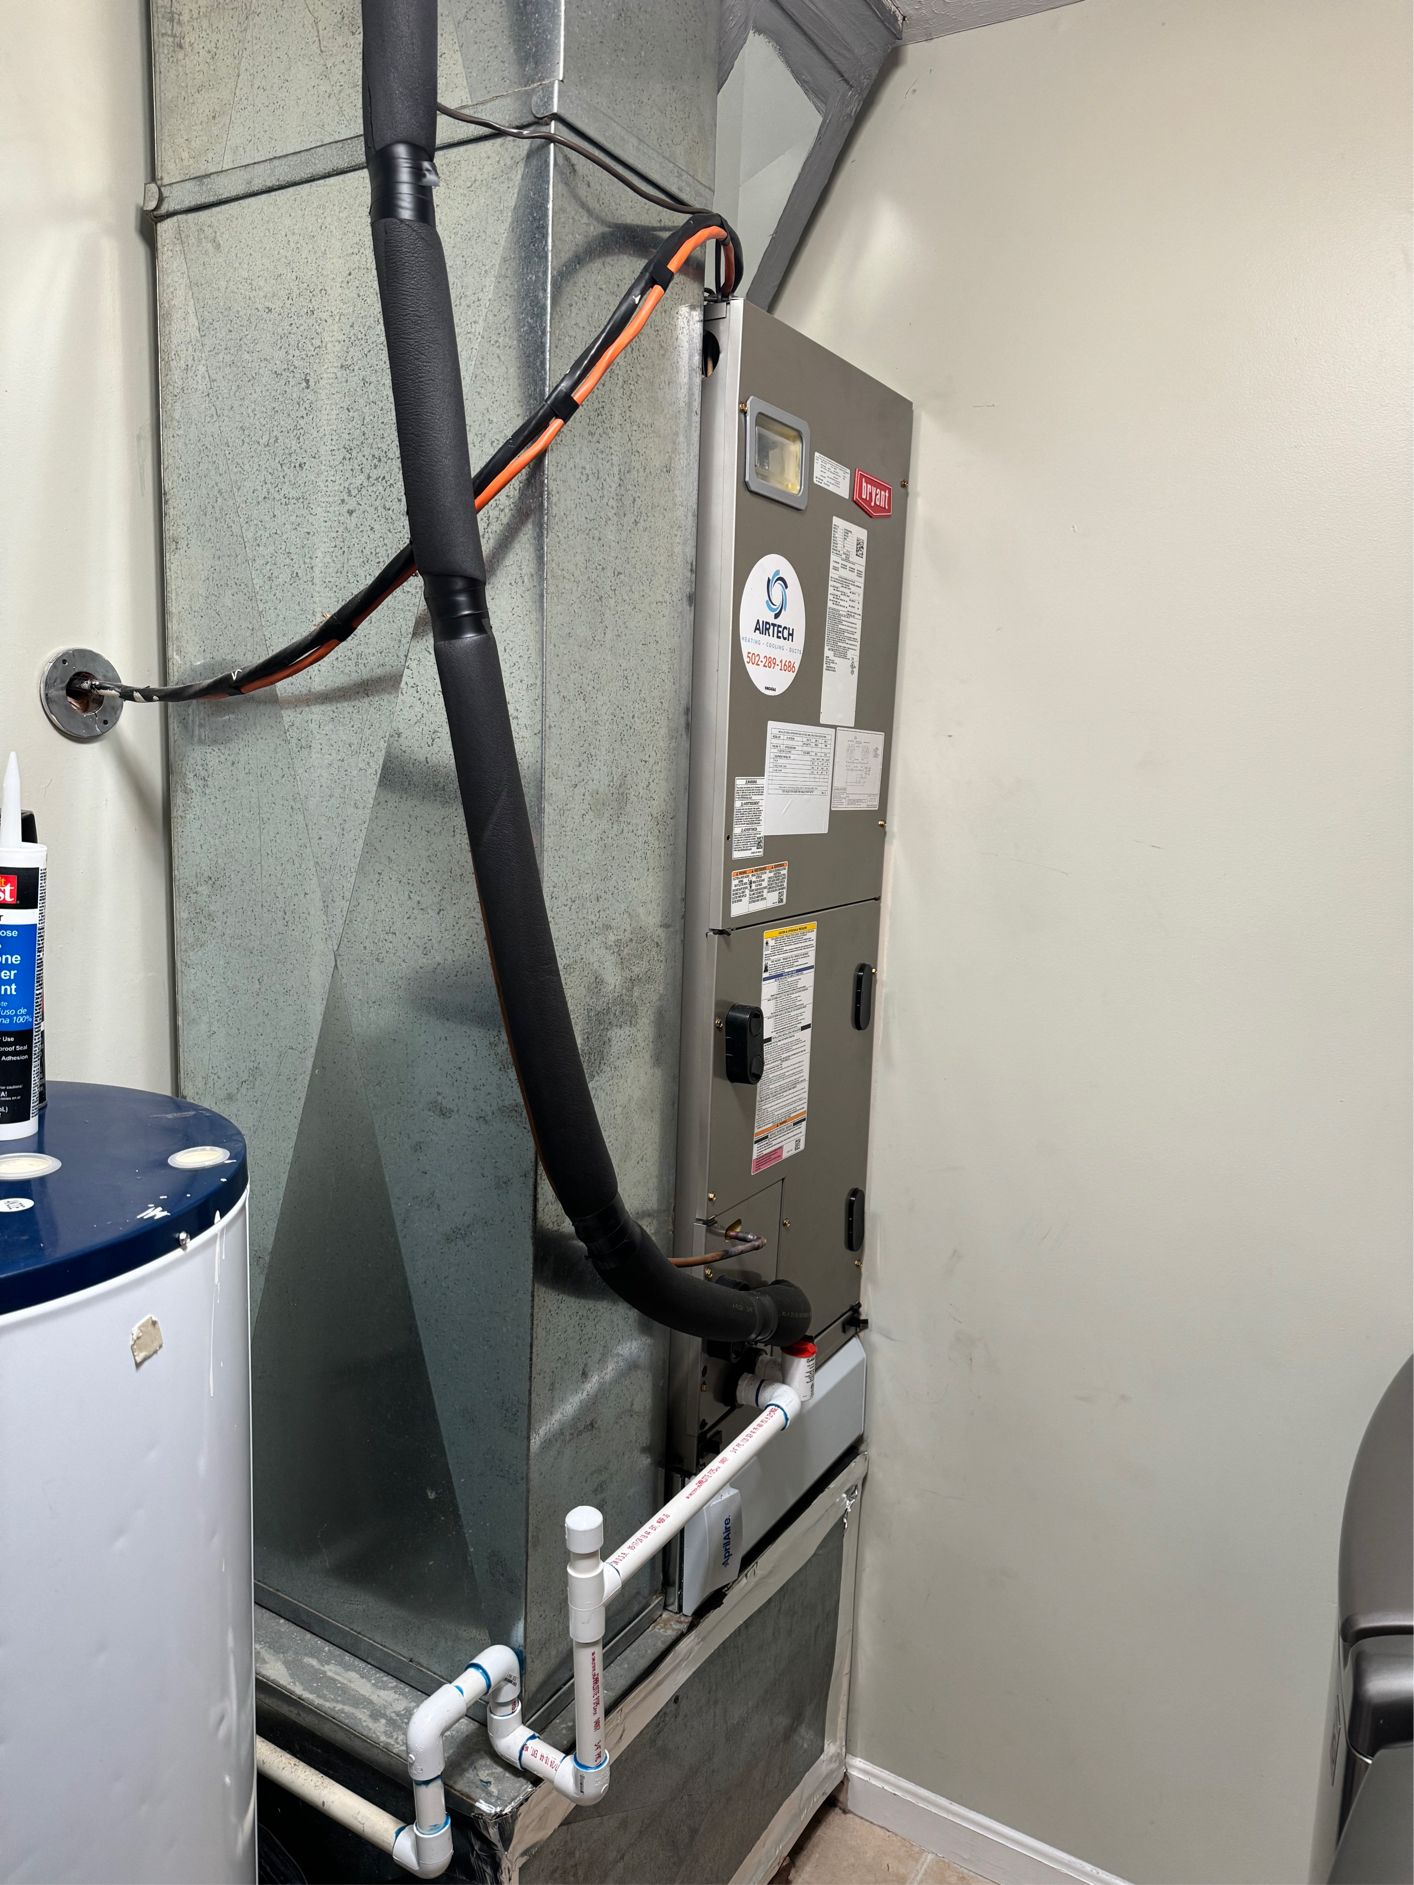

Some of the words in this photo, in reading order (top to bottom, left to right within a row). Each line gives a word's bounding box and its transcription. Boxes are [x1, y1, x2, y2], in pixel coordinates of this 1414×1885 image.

[861, 477, 890, 509] bryant
[754, 618, 795, 642] AIRTECH
[746, 651, 796, 674] 502-289-1686
[0, 954, 21, 964] ne
[1, 969, 17, 980] er
[1, 983, 17, 995] nt
[17, 1006, 28, 1015] de
[13, 1015, 32, 1024] 100%
